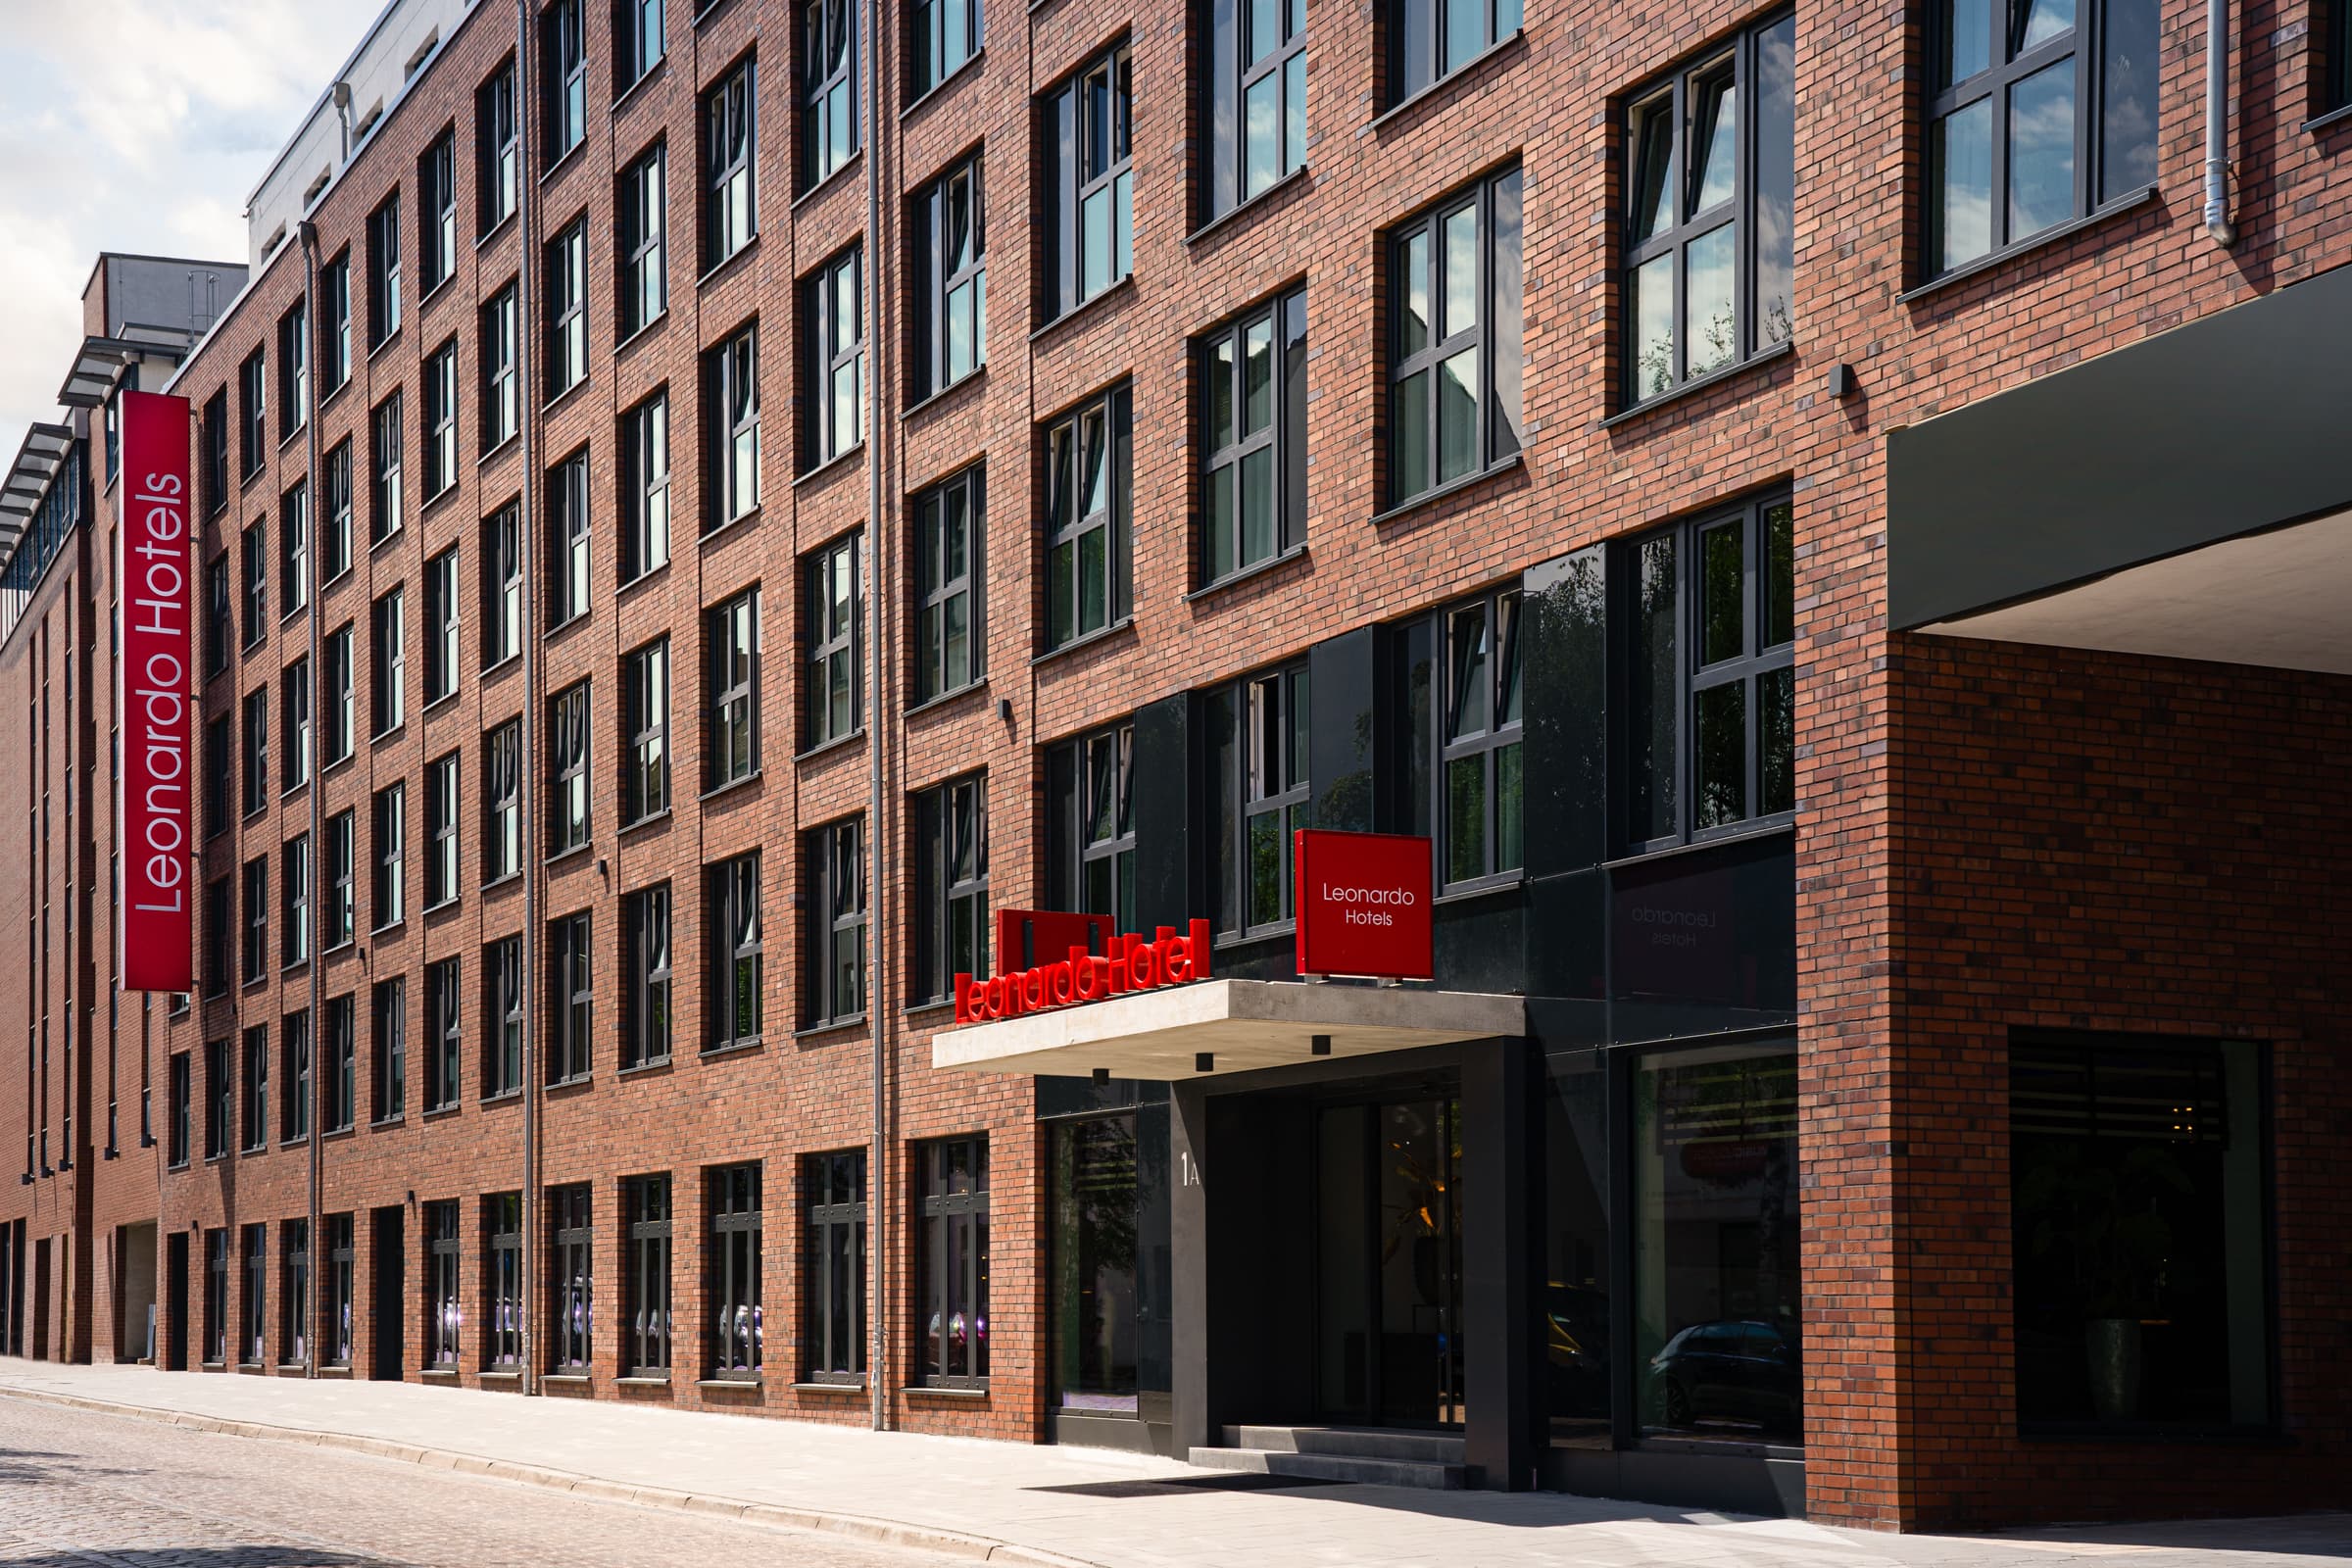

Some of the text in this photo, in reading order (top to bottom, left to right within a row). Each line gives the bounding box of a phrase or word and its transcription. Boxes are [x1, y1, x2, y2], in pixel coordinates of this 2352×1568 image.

[134, 472, 182, 913] Leonardo Hotels
[1323, 882, 1415, 906] Leonardo
[1346, 908, 1393, 926] Hotels
[1107, 918, 1210, 994] Hotel
[1181, 1152, 1200, 1186] 1A
